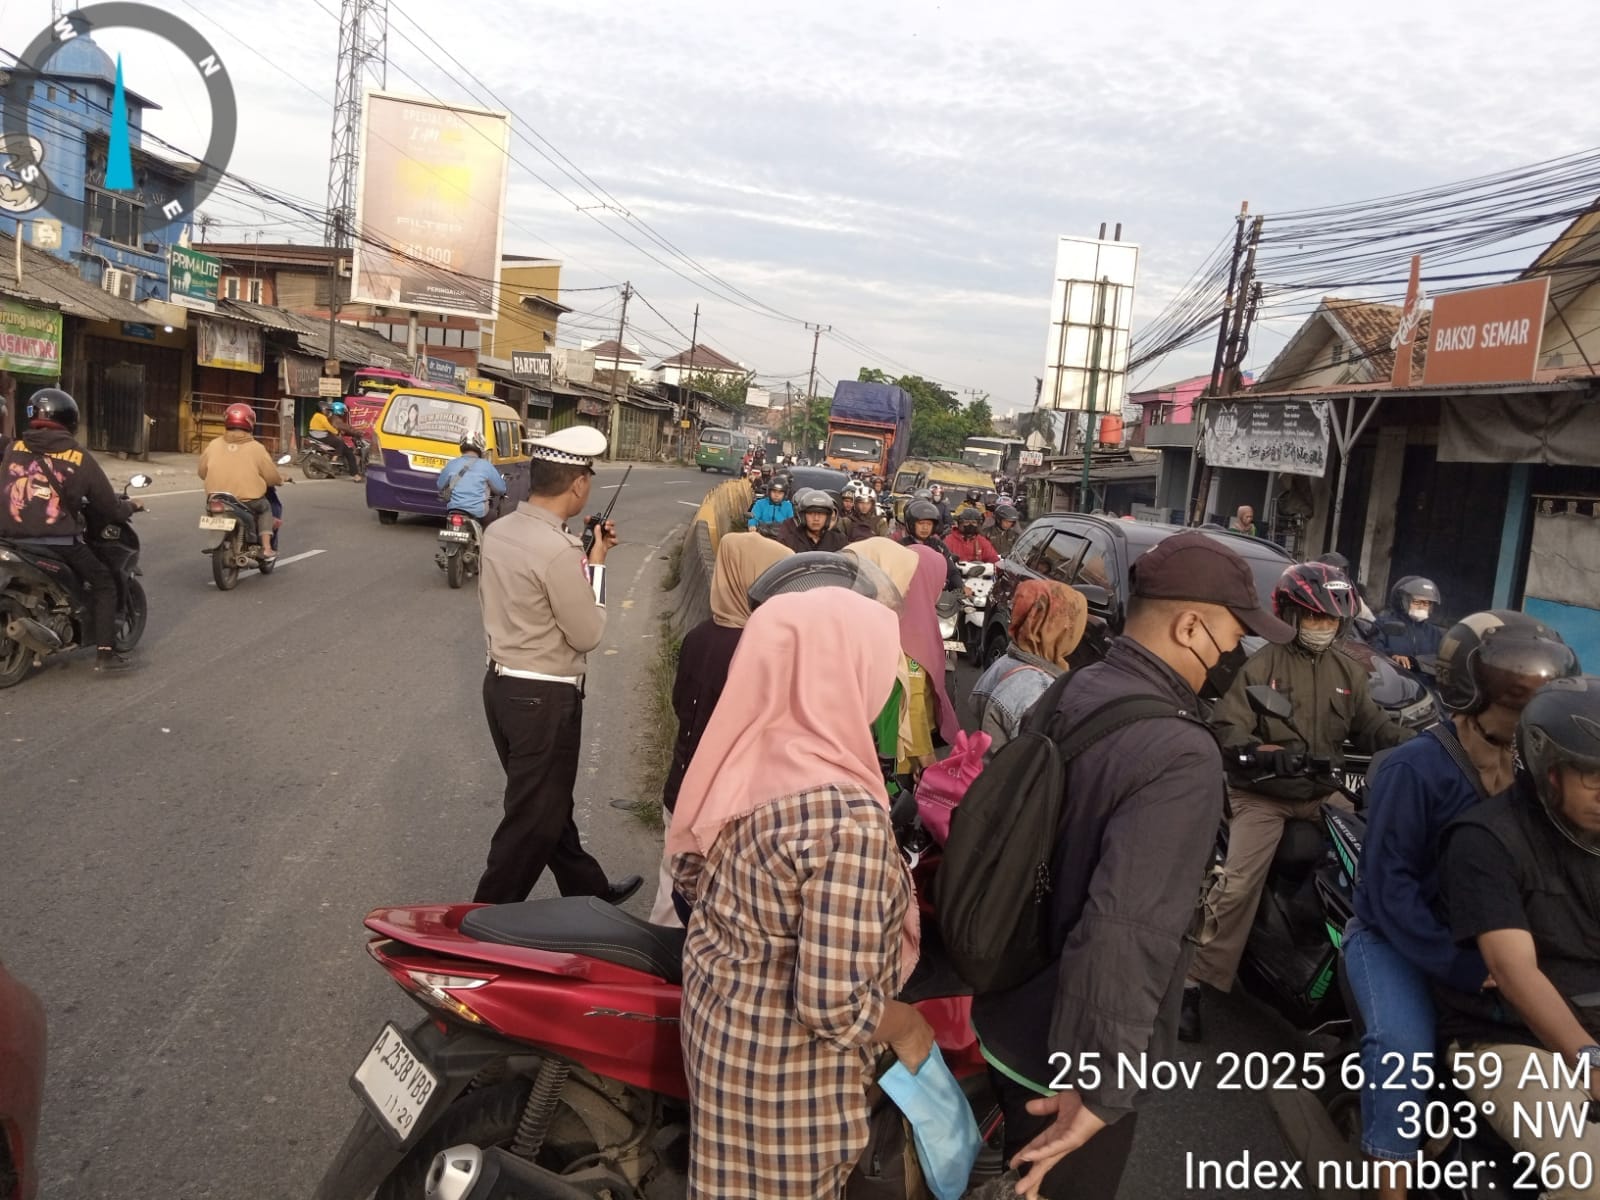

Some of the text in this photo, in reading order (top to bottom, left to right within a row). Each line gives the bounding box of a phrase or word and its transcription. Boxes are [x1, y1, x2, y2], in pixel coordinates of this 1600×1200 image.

[1435, 318, 1530, 352] BAKSO SEMAR
[513, 356, 550, 375] PARFUME
[375, 1031, 390, 1054] A
[381, 1041, 414, 1082] 2538
